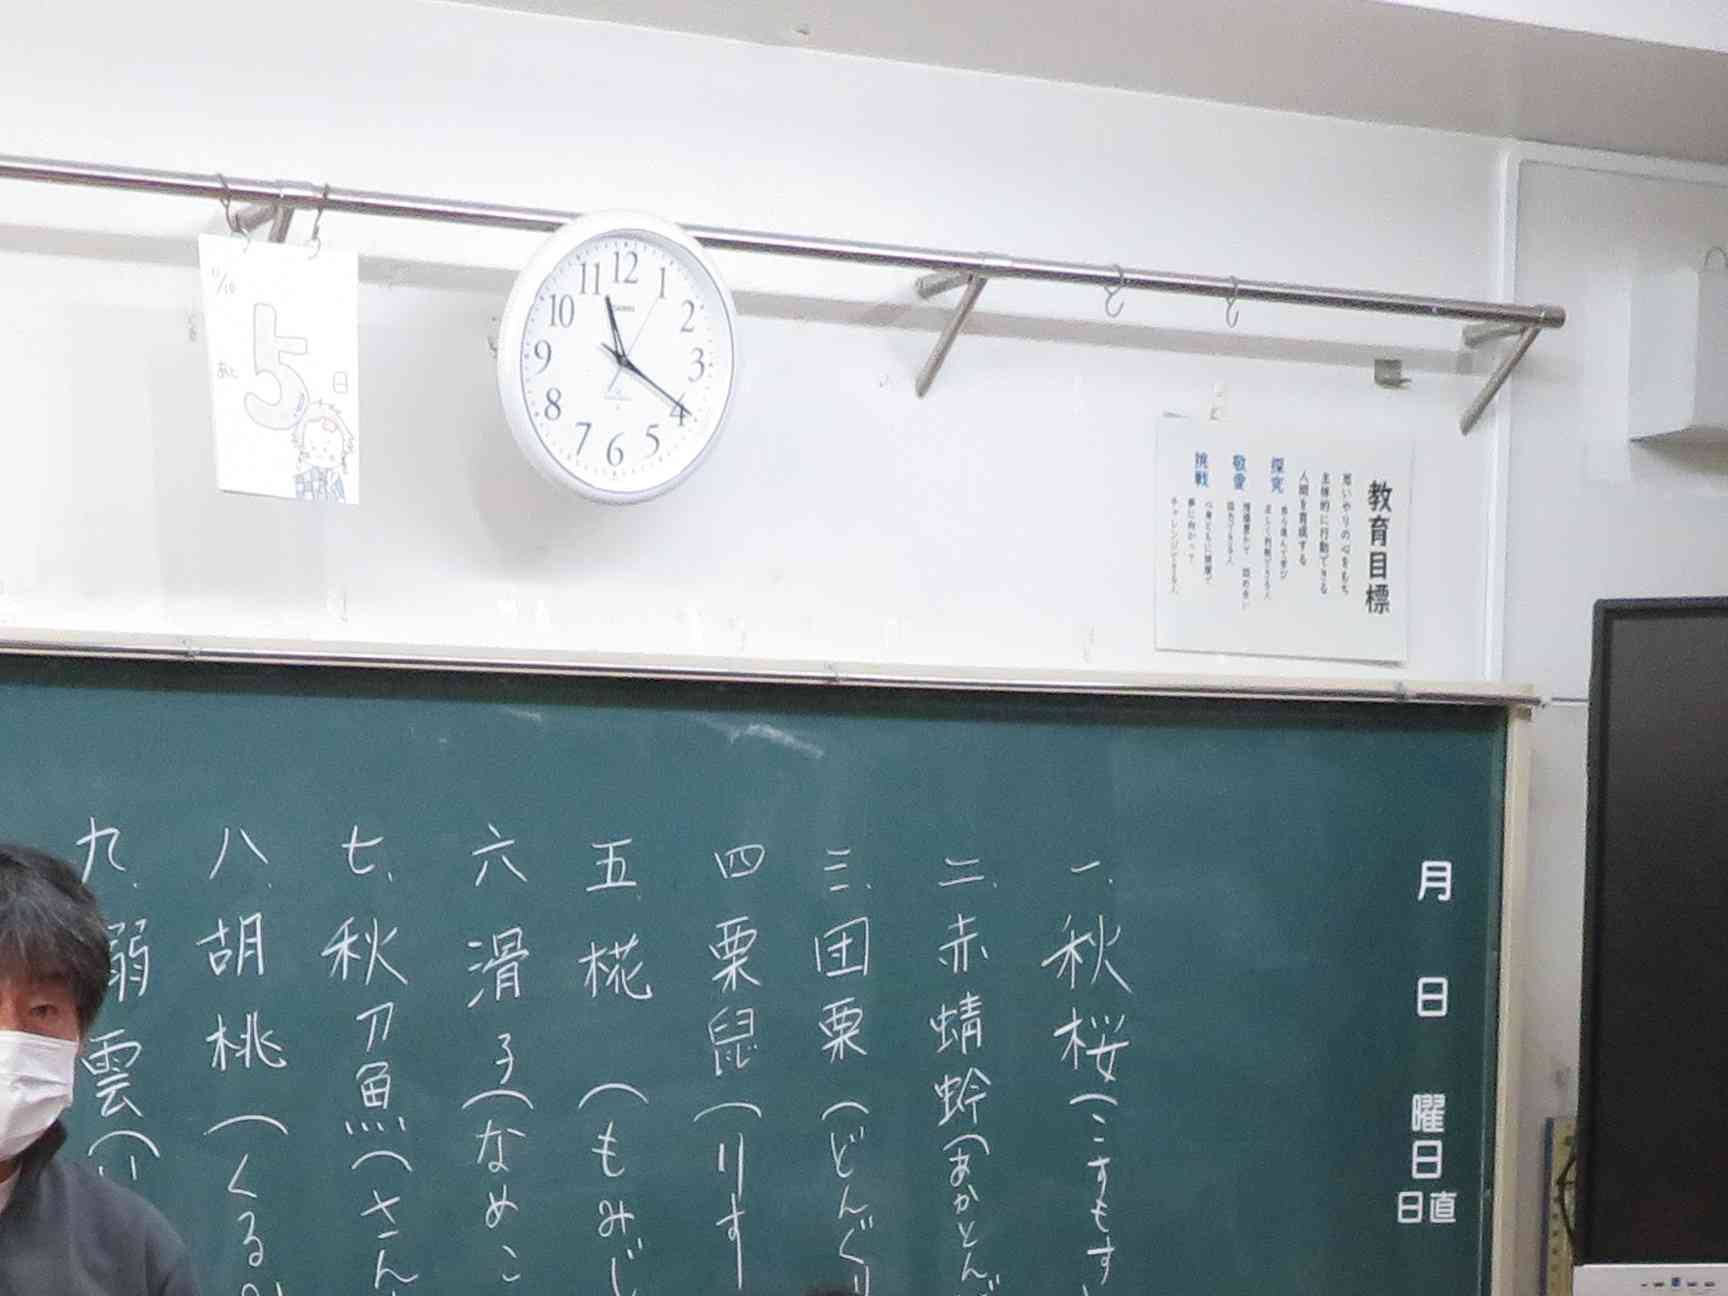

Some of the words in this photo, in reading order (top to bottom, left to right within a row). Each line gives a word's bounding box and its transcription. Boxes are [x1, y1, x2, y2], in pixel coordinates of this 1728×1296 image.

[579, 262, 601, 295] 11
[612, 250, 639, 284] 12
[658, 266, 667, 299] 1
[548, 294, 575, 328] 10
[680, 299, 695, 333] 2
[244, 303, 311, 431] 5
[534, 339, 552, 376] 9
[688, 346, 705, 382] 3
[544, 387, 562, 421] 8
[670, 392, 687, 427] 4
[575, 421, 593, 456] 7
[606, 431, 625, 467] 6
[645, 424, 660, 458] 5
[1365, 479, 1393, 616] 教育目標
[1417, 860, 1452, 901] 月
[1416, 977, 1448, 1018] 日
[1410, 1093, 1445, 1180] 曜日
[1396, 1190, 1457, 1223] 日直
